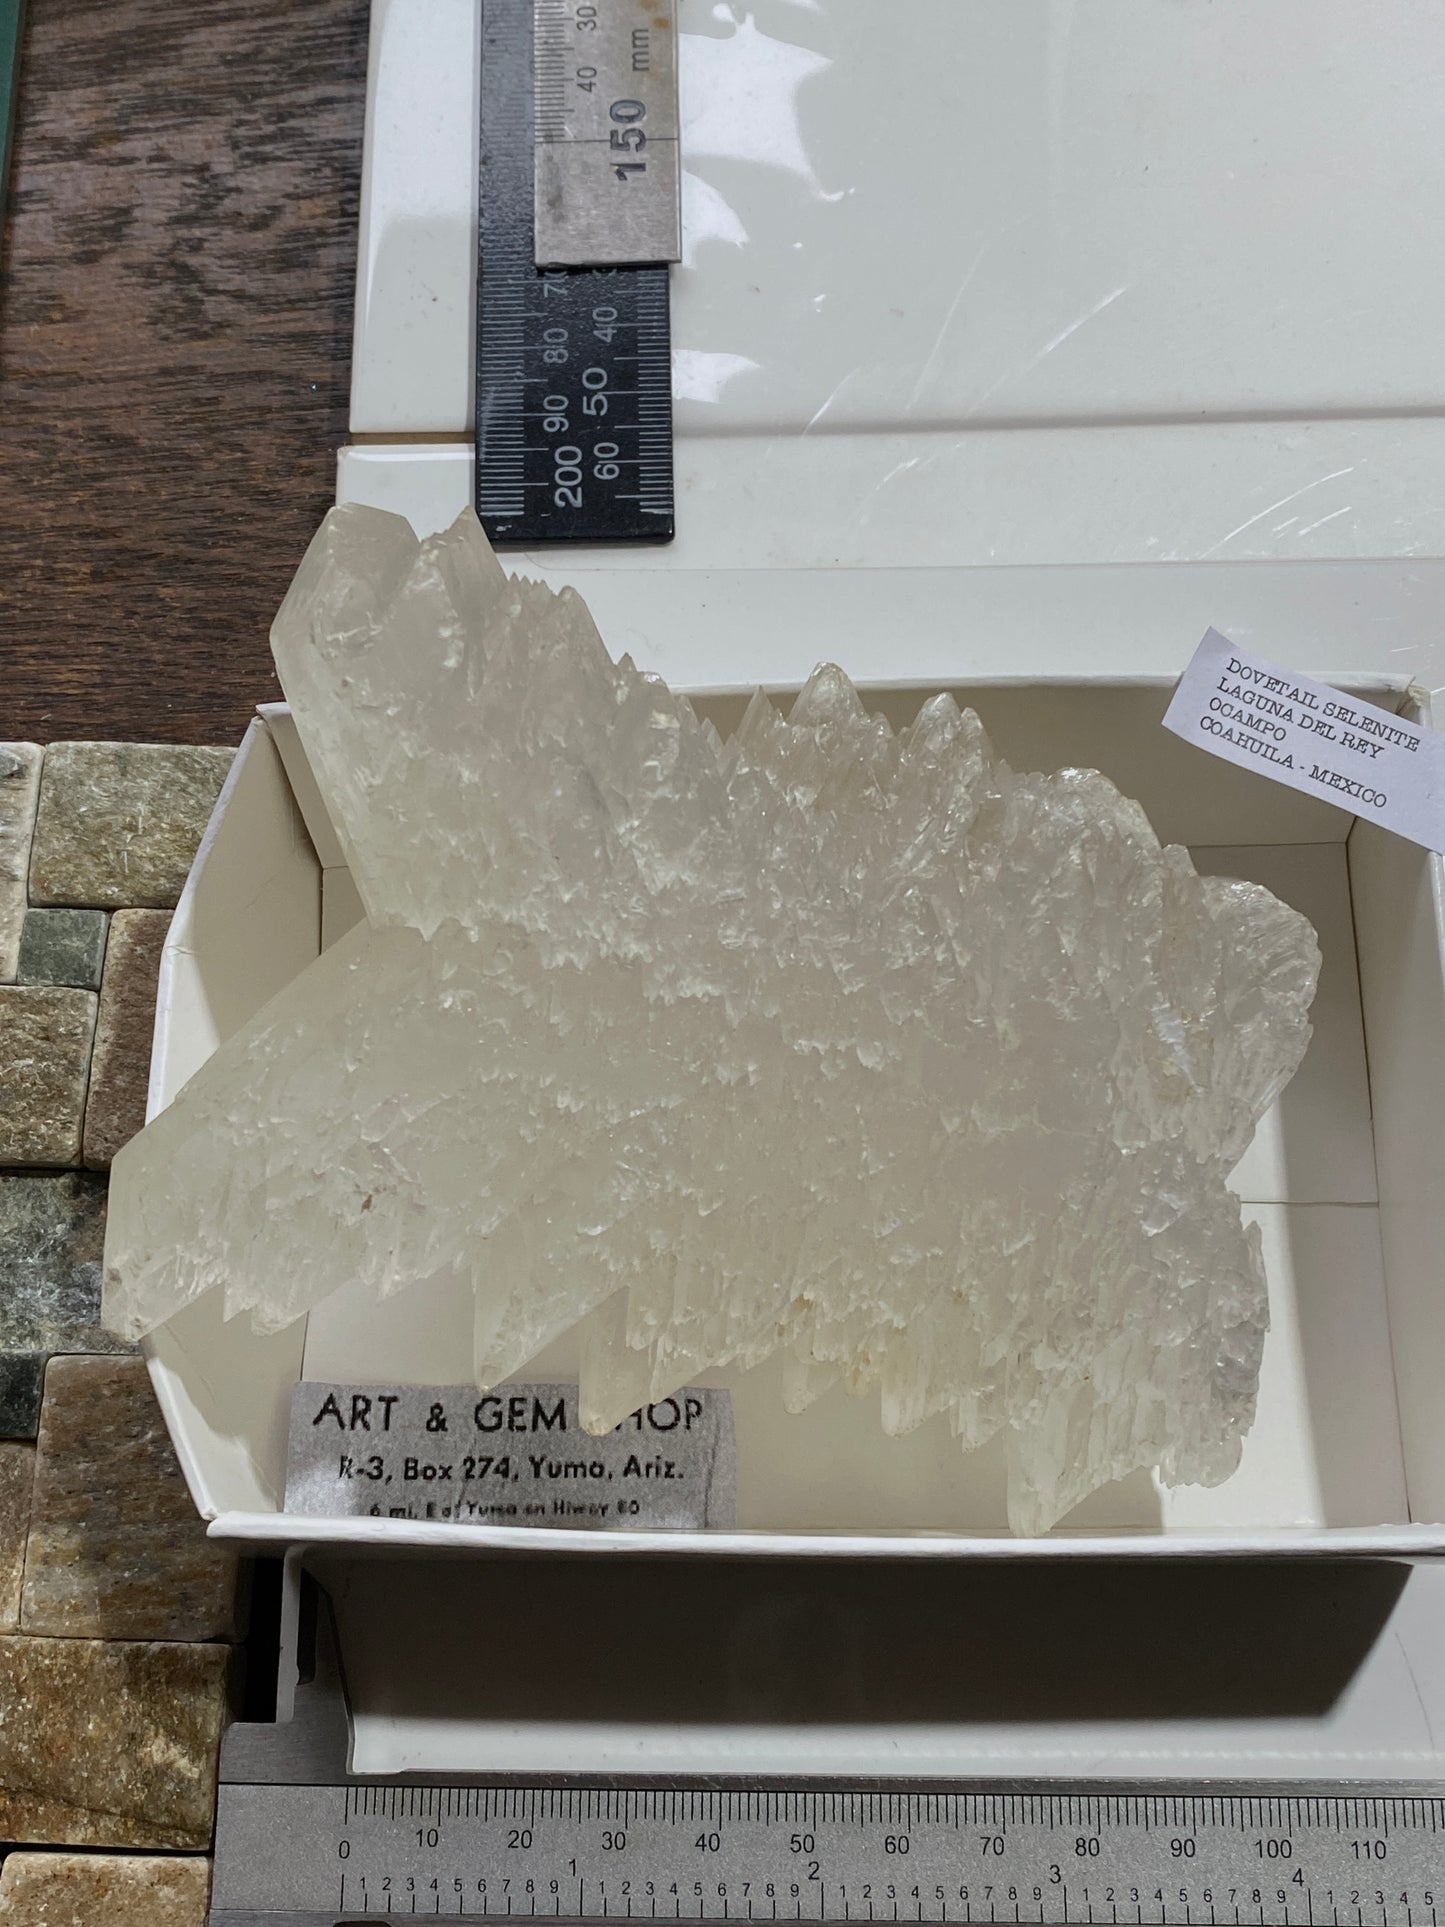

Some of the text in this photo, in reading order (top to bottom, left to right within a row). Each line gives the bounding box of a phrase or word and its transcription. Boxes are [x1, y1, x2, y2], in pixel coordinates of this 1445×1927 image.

[577, 6, 597, 93] 40 30
[632, 29, 649, 72] mm
[609, 99, 647, 182] 150
[543, 328, 569, 363] 80
[593, 307, 618, 343] 40
[582, 367, 608, 416] 50
[543, 395, 569, 433] 90
[554, 445, 583, 509] 200
[593, 442, 619, 480] 60
[1209, 696, 1287, 741] OCAMPO
[1216, 677, 1385, 760] LAGUNA DEL REY
[1226, 657, 1421, 753] DOVETAIL SELENITE
[1199, 715, 1295, 769] COAHUILA
[1308, 764, 1388, 808] MEXICO
[312, 1392, 704, 1432] ART & GEM HOP
[404, 1456, 453, 1481] Box
[529, 1455, 614, 1481] Yuma,
[623, 1454, 684, 1480] Ariz.
[338, 1828, 1386, 1860] 0 10 20 30 40 50 60 70 80 90 100 110
[381, 1876, 391, 1890] 2
[406, 1876, 414, 1891] 3
[429, 1877, 438, 1891] 4
[453, 1877, 462, 1892] 5
[477, 1878, 486, 1892] 6
[502, 1878, 510, 1893] 7
[525, 1878, 534, 1893] 8
[549, 1879, 558, 1893] 9
[621, 1880, 630, 1895] 2
[645, 1880, 654, 1895] 3
[668, 1881, 678, 1895] 4
[693, 1881, 702, 1896] 5
[717, 1882, 726, 1896] 6
[741, 1882, 750, 1896] 7
[765, 1882, 774, 1897] 8
[789, 1883, 799, 1897] 9
[862, 1883, 872, 1898] 2
[886, 1884, 895, 1899] 3
[910, 1885, 919, 1899] 4
[935, 1885, 944, 1899] 5
[959, 1885, 968, 1900] 6
[983, 1885, 993, 1900] 7
[1007, 1886, 1017, 1900] 8
[1032, 1886, 1041, 1900] 9
[1105, 1887, 1114, 1901] 2
[1130, 1887, 1139, 1902] 3
[1153, 1887, 1162, 1902] 4
[1178, 1887, 1187, 1902] 5
[1203, 1888, 1212, 1902] 6
[1227, 1888, 1236, 1903] 7
[1251, 1888, 1261, 1903] 8
[1276, 1888, 1286, 1903] 9
[1350, 1889, 1359, 1904] 2
[1374, 1890, 1384, 1904] 3
[1399, 1891, 1408, 1905] 4
[1424, 1890, 1433, 1905] 5
[568, 1857, 1304, 1887] 1 2 3 4
